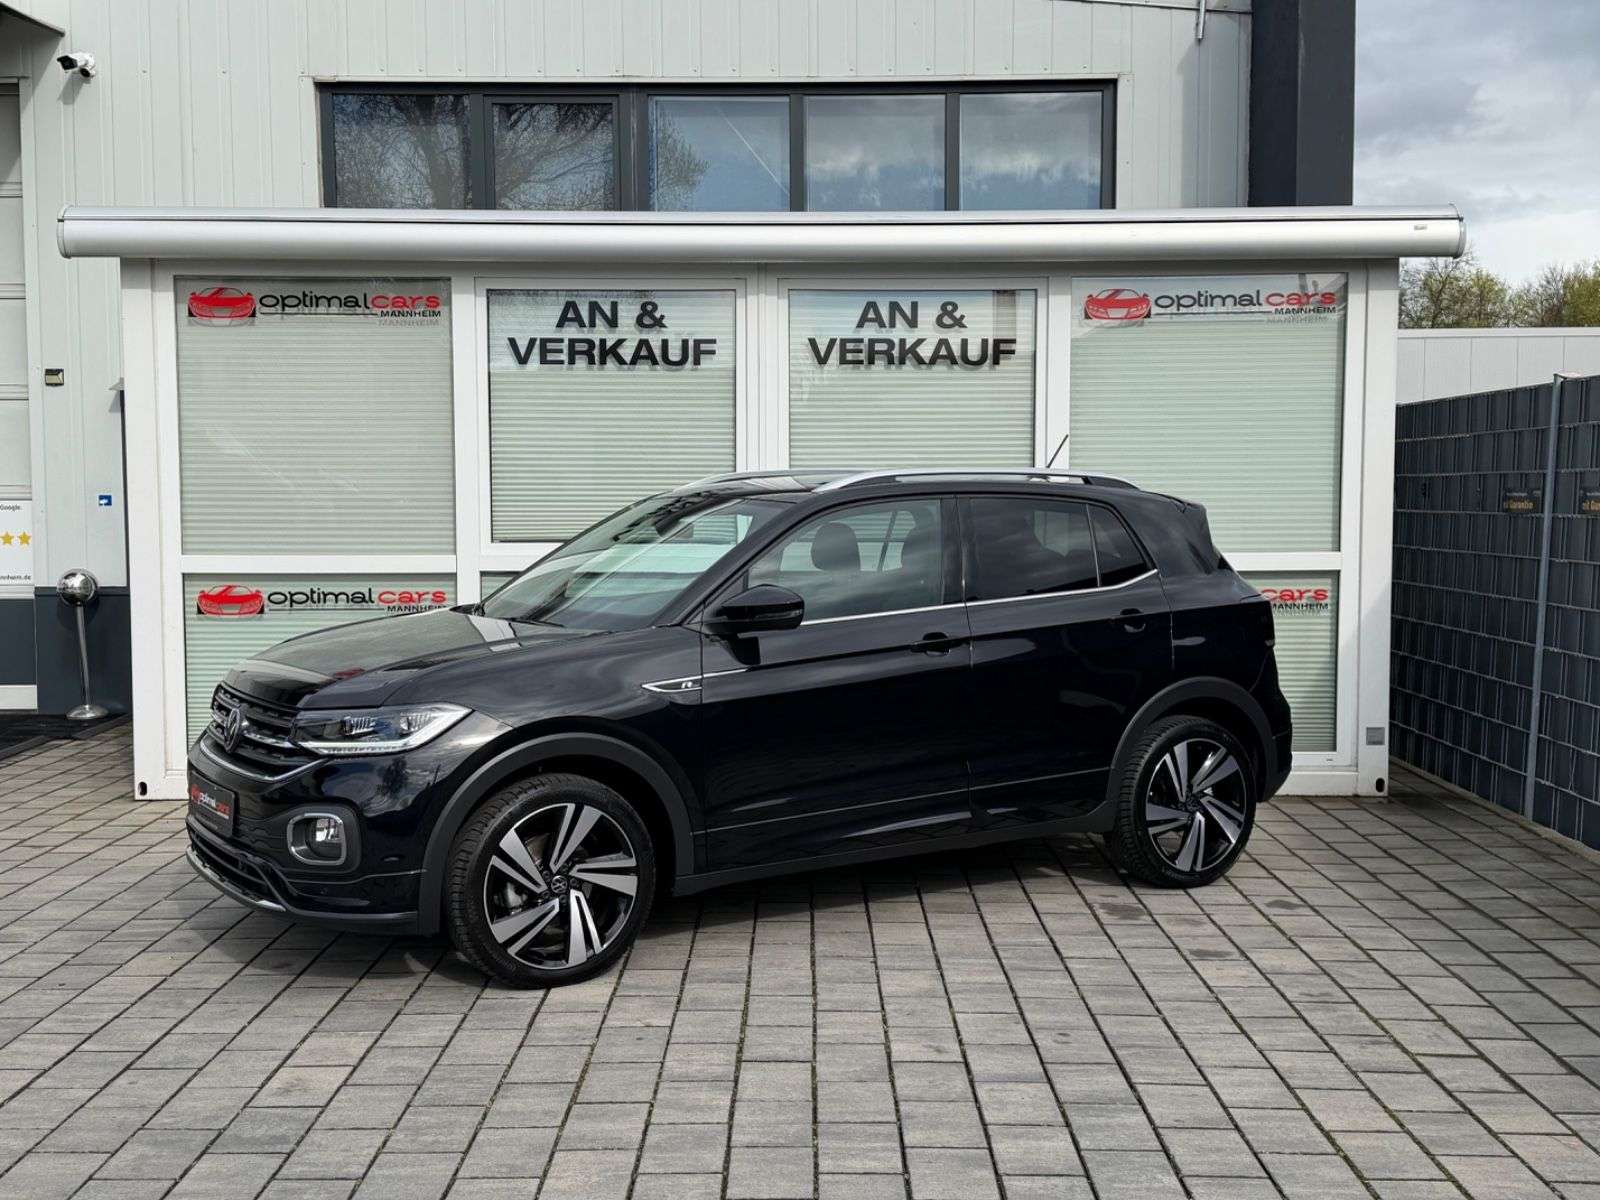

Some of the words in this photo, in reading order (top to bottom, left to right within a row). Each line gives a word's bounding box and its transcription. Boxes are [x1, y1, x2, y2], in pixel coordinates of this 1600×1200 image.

[555, 300, 619, 329] AN
[635, 300, 668, 329] &
[855, 300, 919, 329] AN
[935, 300, 968, 329] &
[1274, 306, 1337, 315] MANNHEIM
[507, 337, 717, 366] VERKAUF
[807, 337, 1017, 366] VERKAUF
